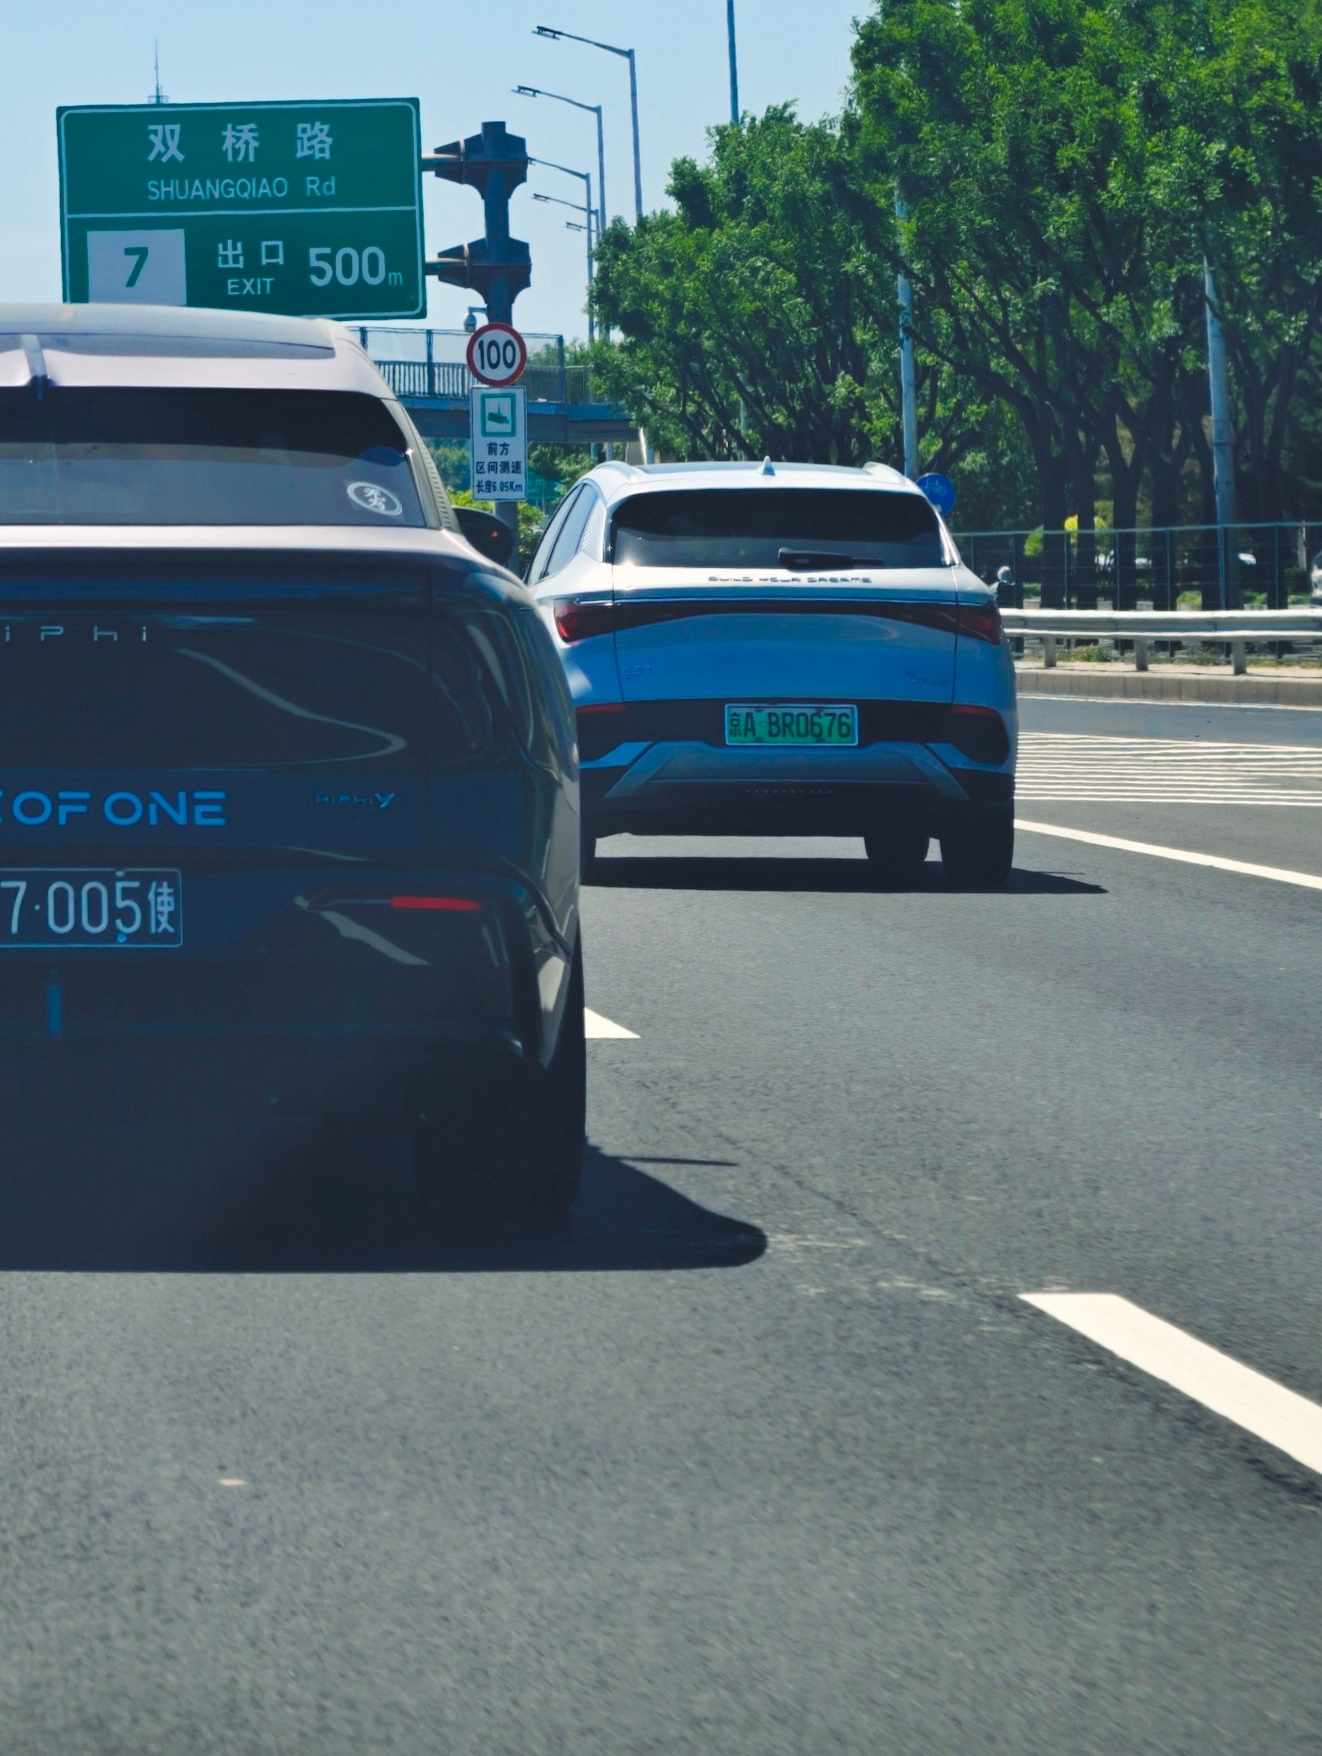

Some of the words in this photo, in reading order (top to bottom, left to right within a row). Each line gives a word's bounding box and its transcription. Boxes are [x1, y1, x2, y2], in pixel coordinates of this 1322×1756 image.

[147, 121, 333, 163] 双桥路
[148, 177, 289, 200] SHUANGQIAO
[306, 175, 336, 196] Rd
[123, 246, 149, 288] 7
[217, 239, 284, 269] 出口
[227, 278, 275, 295] EXIT
[478, 339, 516, 370] 100
[486, 442, 510, 456] 前方
[12, 791, 91, 825] OF
[103, 791, 226, 826] ONE
